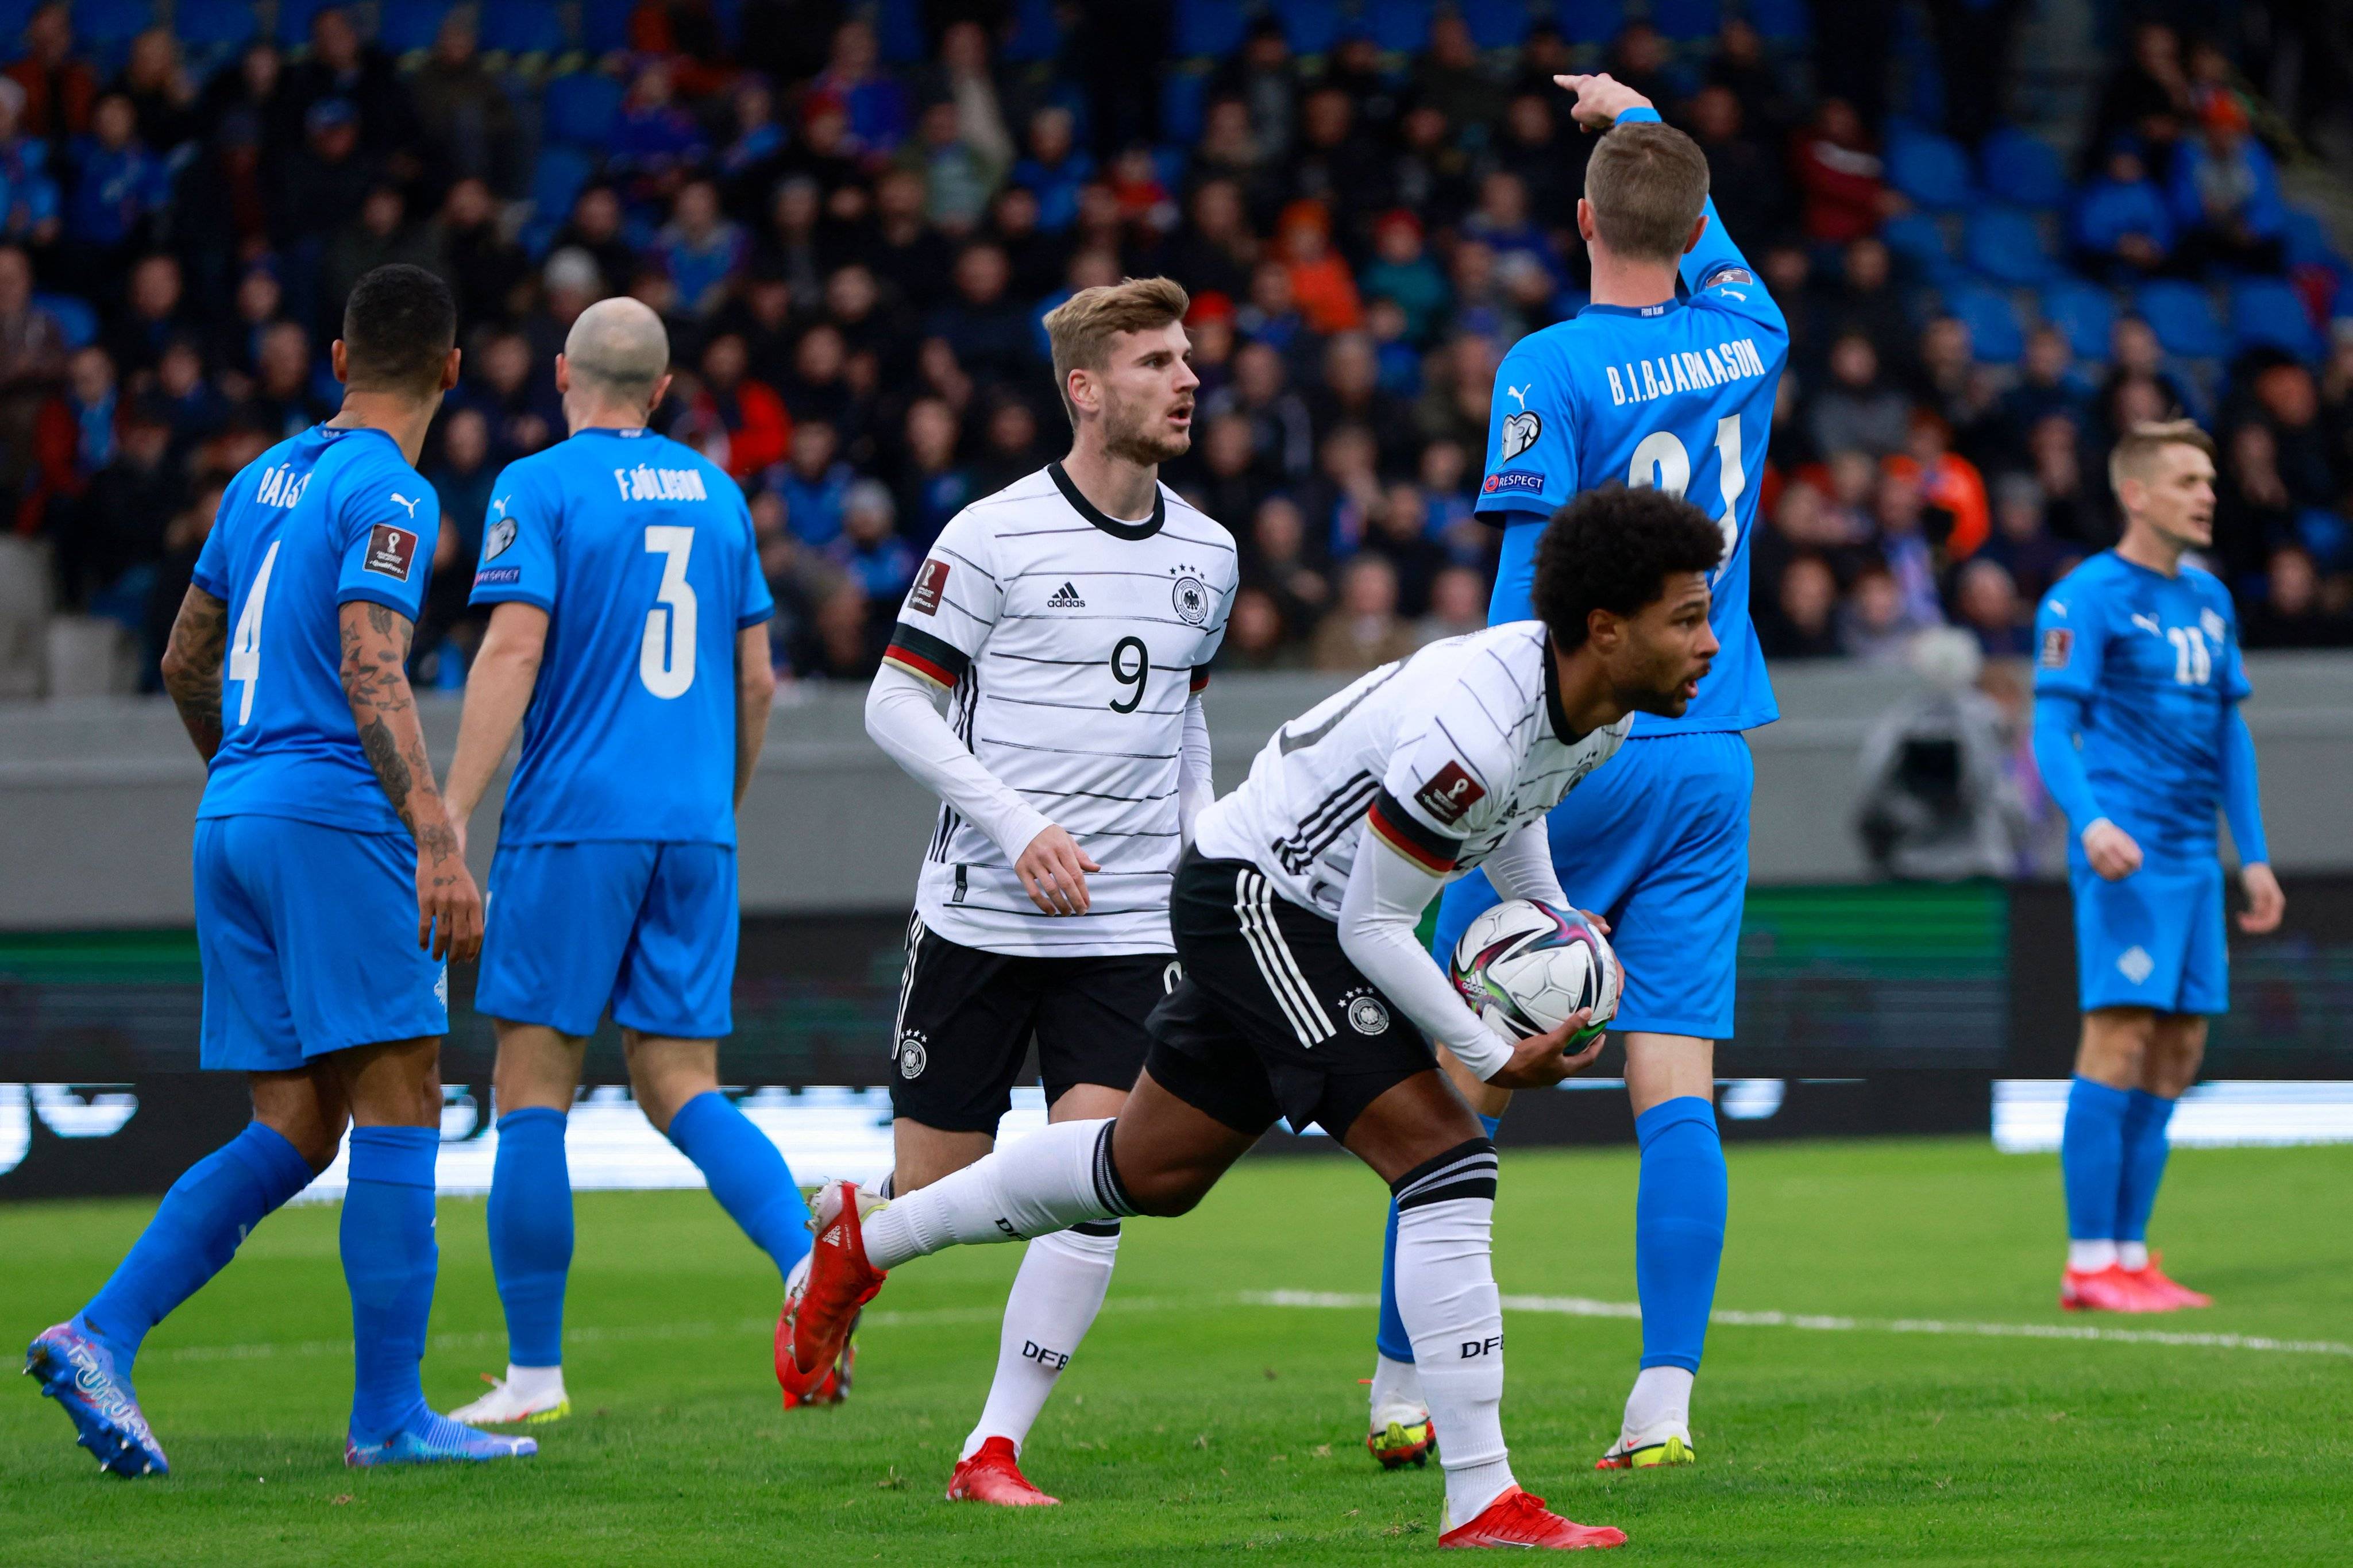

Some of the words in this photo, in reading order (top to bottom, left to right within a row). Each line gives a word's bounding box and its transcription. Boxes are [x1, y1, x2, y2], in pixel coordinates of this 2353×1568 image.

[1606, 338, 1765, 405] B.I.BJARNASON
[1499, 475, 1543, 488] RESPECT
[639, 525, 697, 700] 3
[1047, 598, 1086, 607] adidas
[229, 539, 281, 726] 4
[1109, 636, 1150, 714] 9
[1462, 982, 1487, 995] adidas
[994, 1217, 1032, 1241] DF
[1022, 1340, 1069, 1371] DFB
[1461, 1334, 1504, 1359] DF
